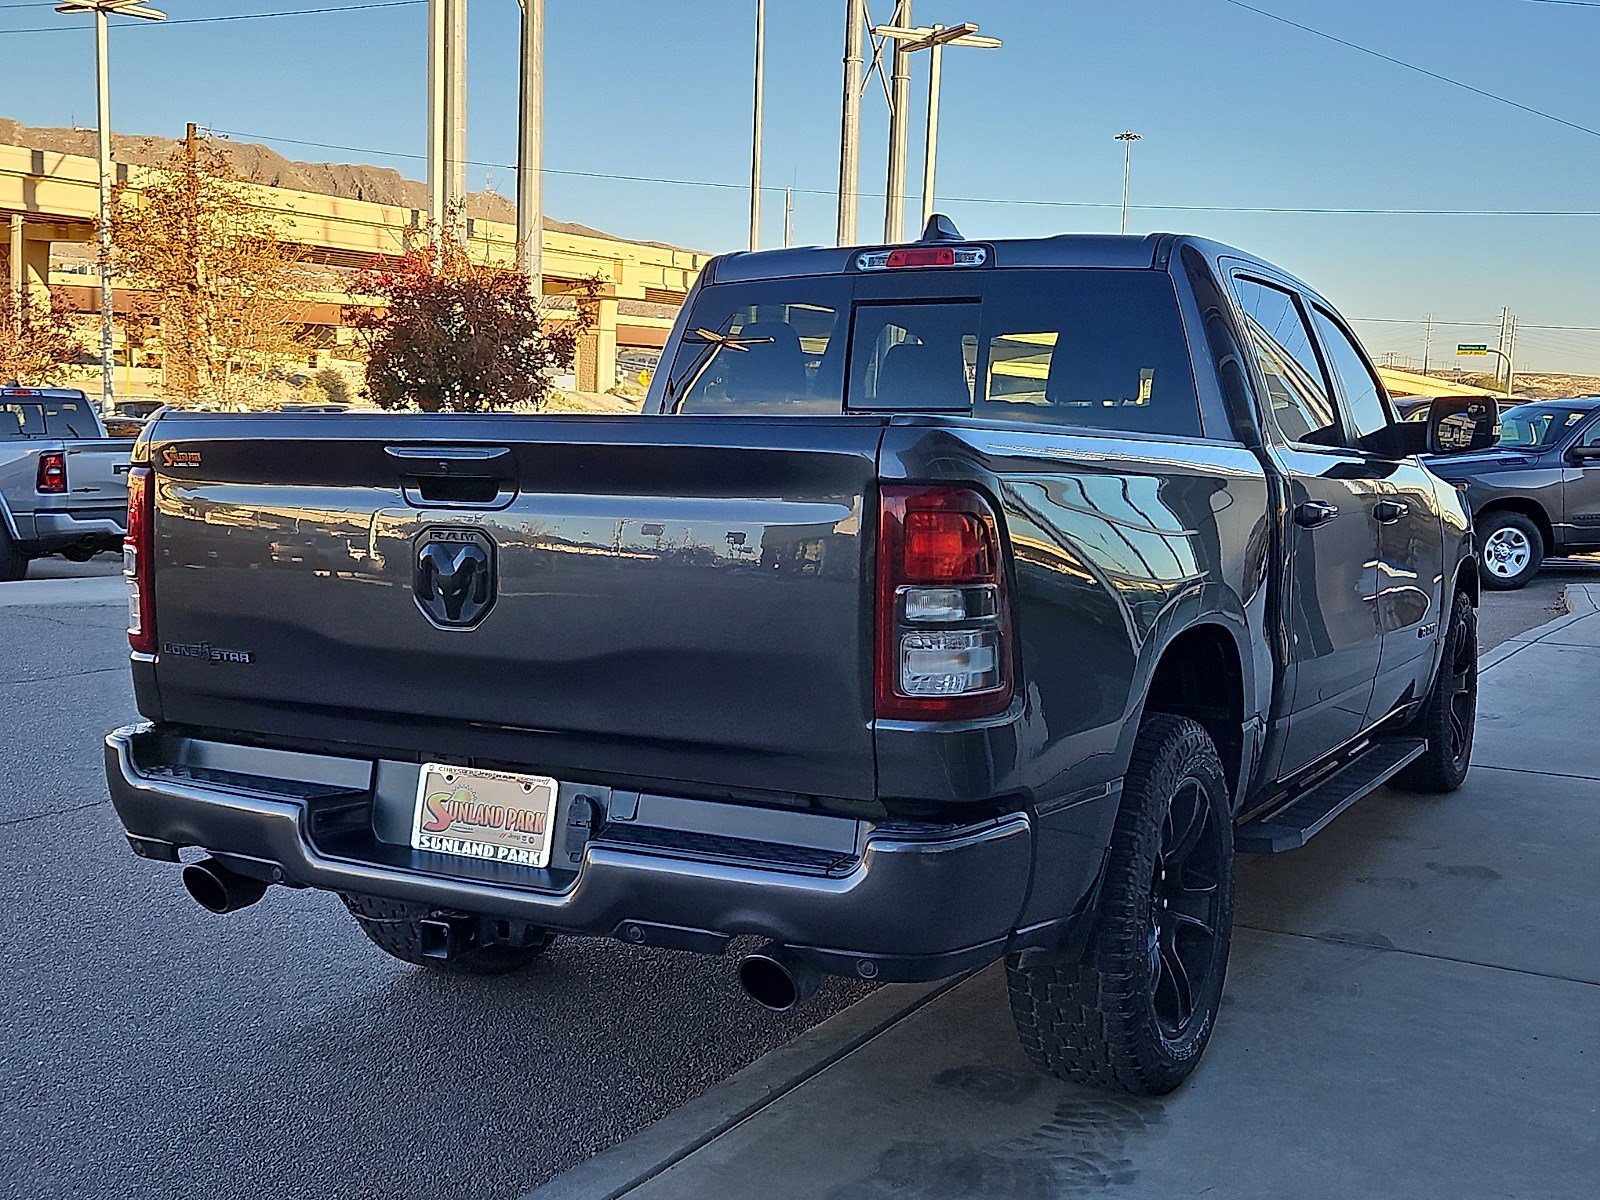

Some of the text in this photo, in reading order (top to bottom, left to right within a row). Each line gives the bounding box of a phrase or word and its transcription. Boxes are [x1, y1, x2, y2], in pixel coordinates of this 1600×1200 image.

[429, 532, 477, 541] RAM
[163, 642, 250, 663] LONE STAR
[423, 792, 546, 835] SUNLAND PARK
[419, 835, 541, 865] SUNLAND PARK
